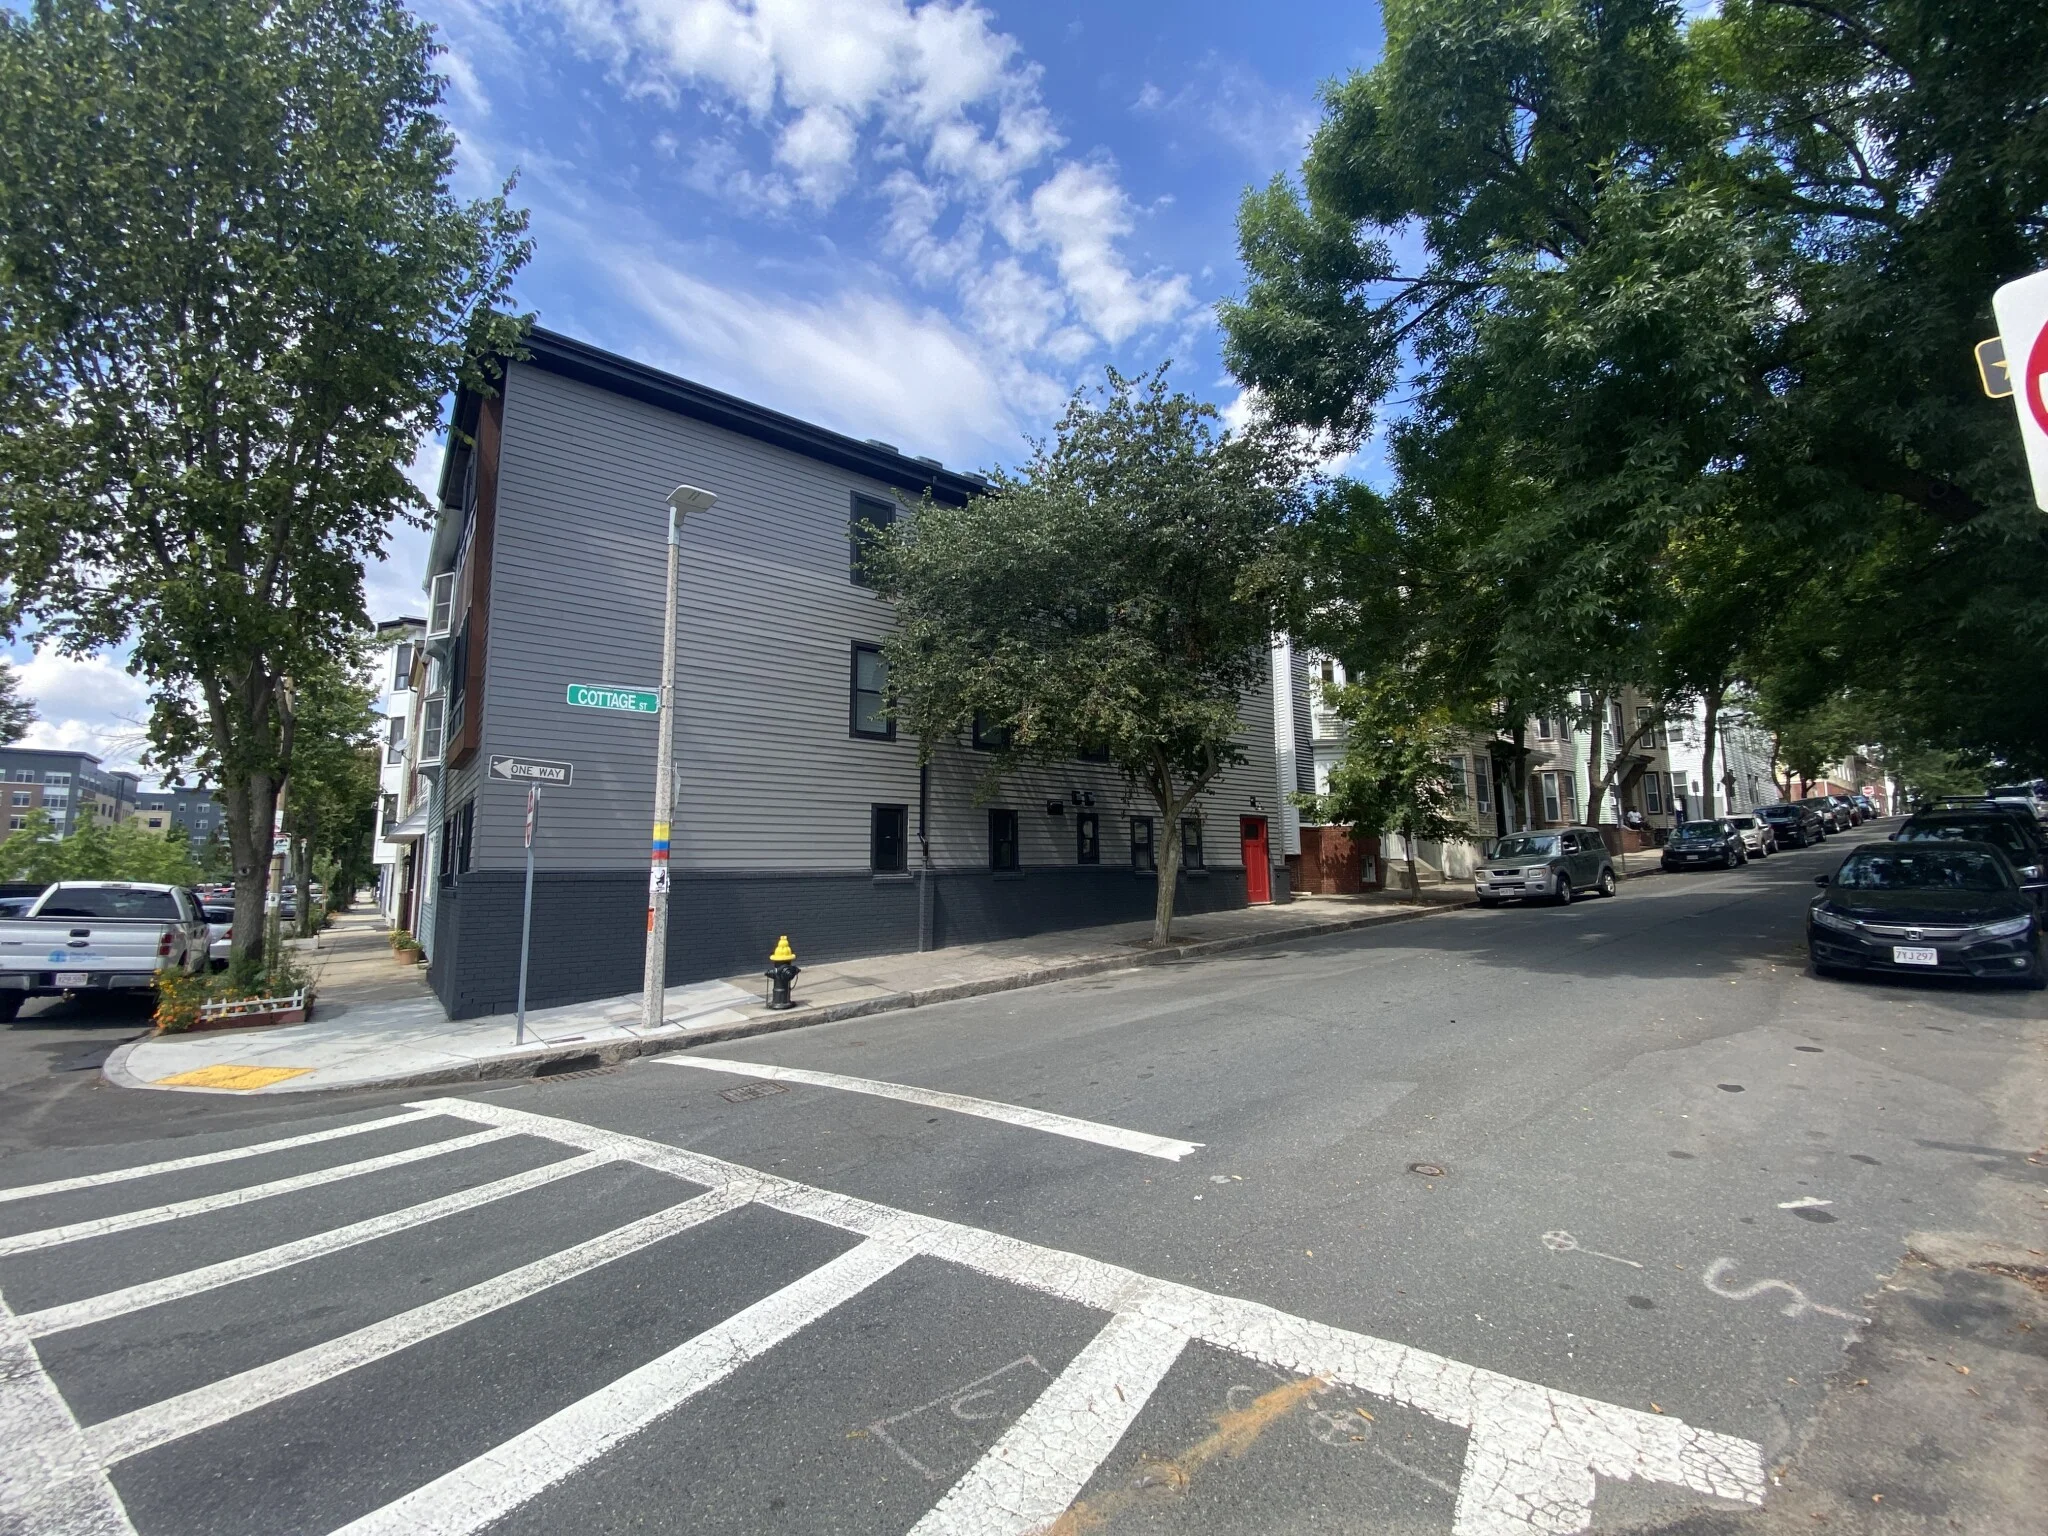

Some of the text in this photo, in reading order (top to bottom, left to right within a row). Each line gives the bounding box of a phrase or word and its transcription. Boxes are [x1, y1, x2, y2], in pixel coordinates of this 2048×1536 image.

[578, 689, 648, 711] COTTAGE ST
[511, 764, 562, 778] ONE WAY
